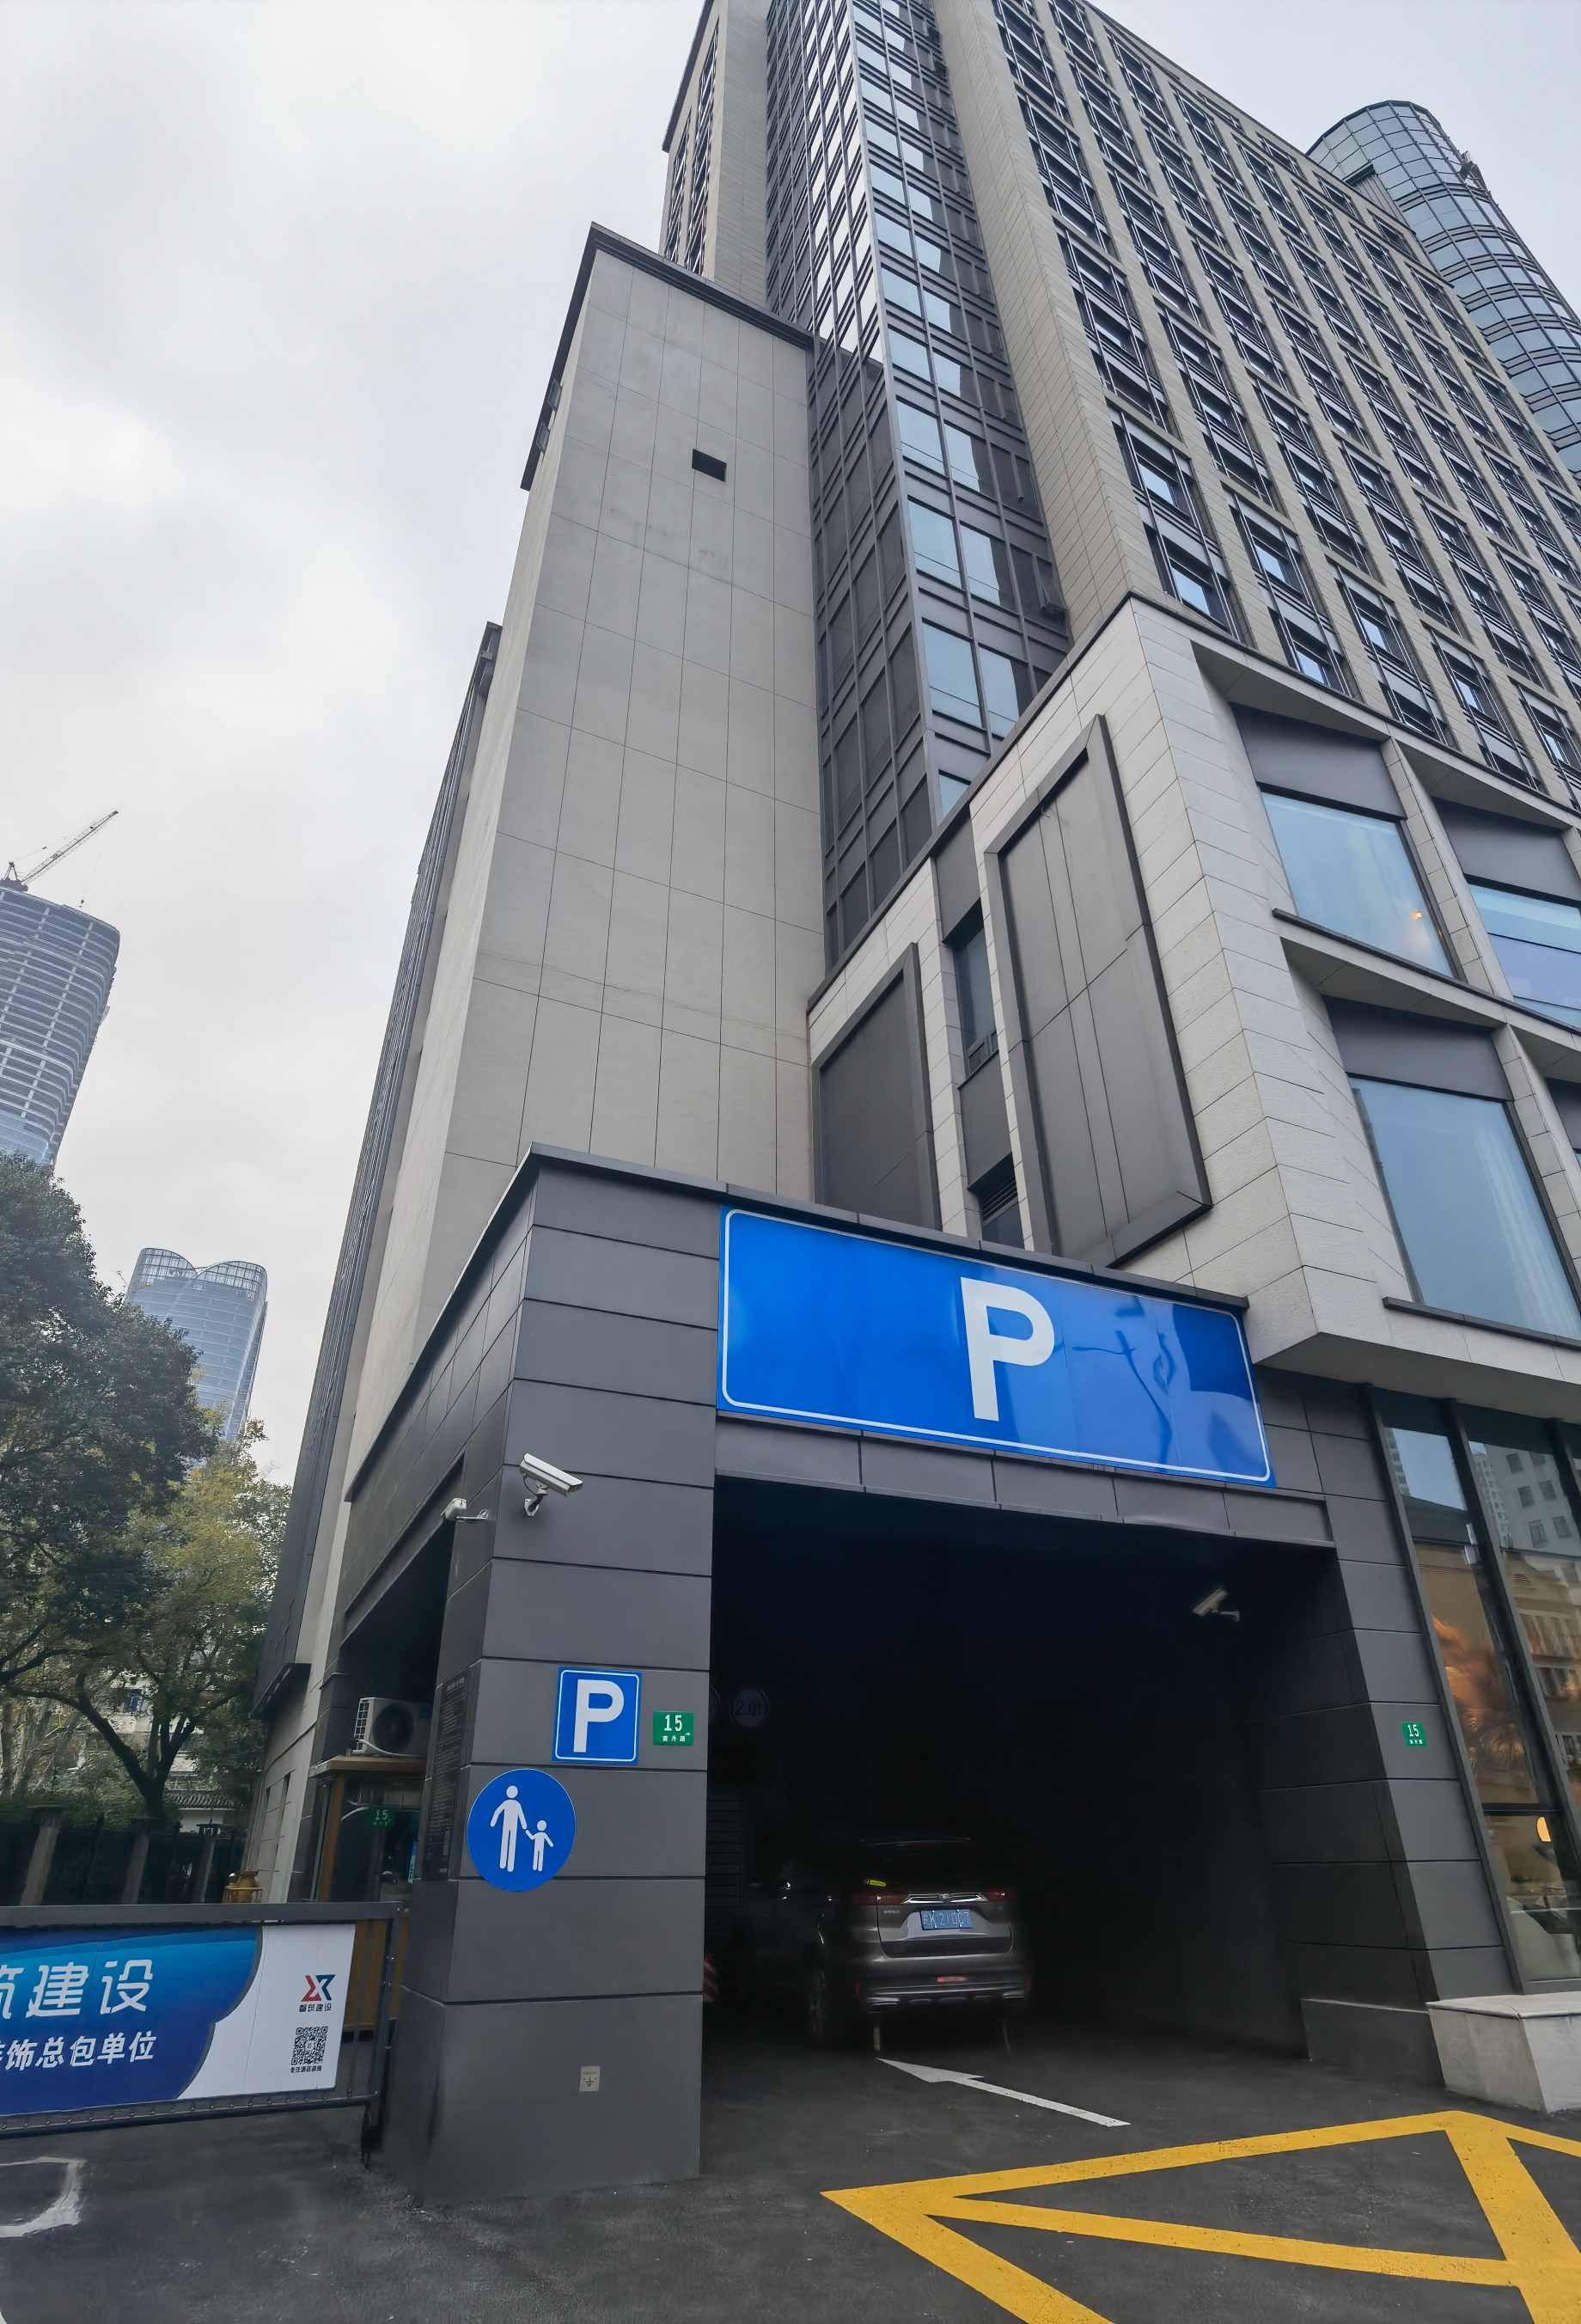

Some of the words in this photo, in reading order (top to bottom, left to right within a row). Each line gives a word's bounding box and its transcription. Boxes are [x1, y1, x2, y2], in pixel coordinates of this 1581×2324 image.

[960, 1276, 1055, 1422] P
[573, 1679, 625, 1753] P
[664, 1714, 683, 1732] 15
[1407, 1724, 1419, 1737] 15
[375, 1808, 388, 1820] 15
[0, 2029, 157, 2071] 饰总包单位
